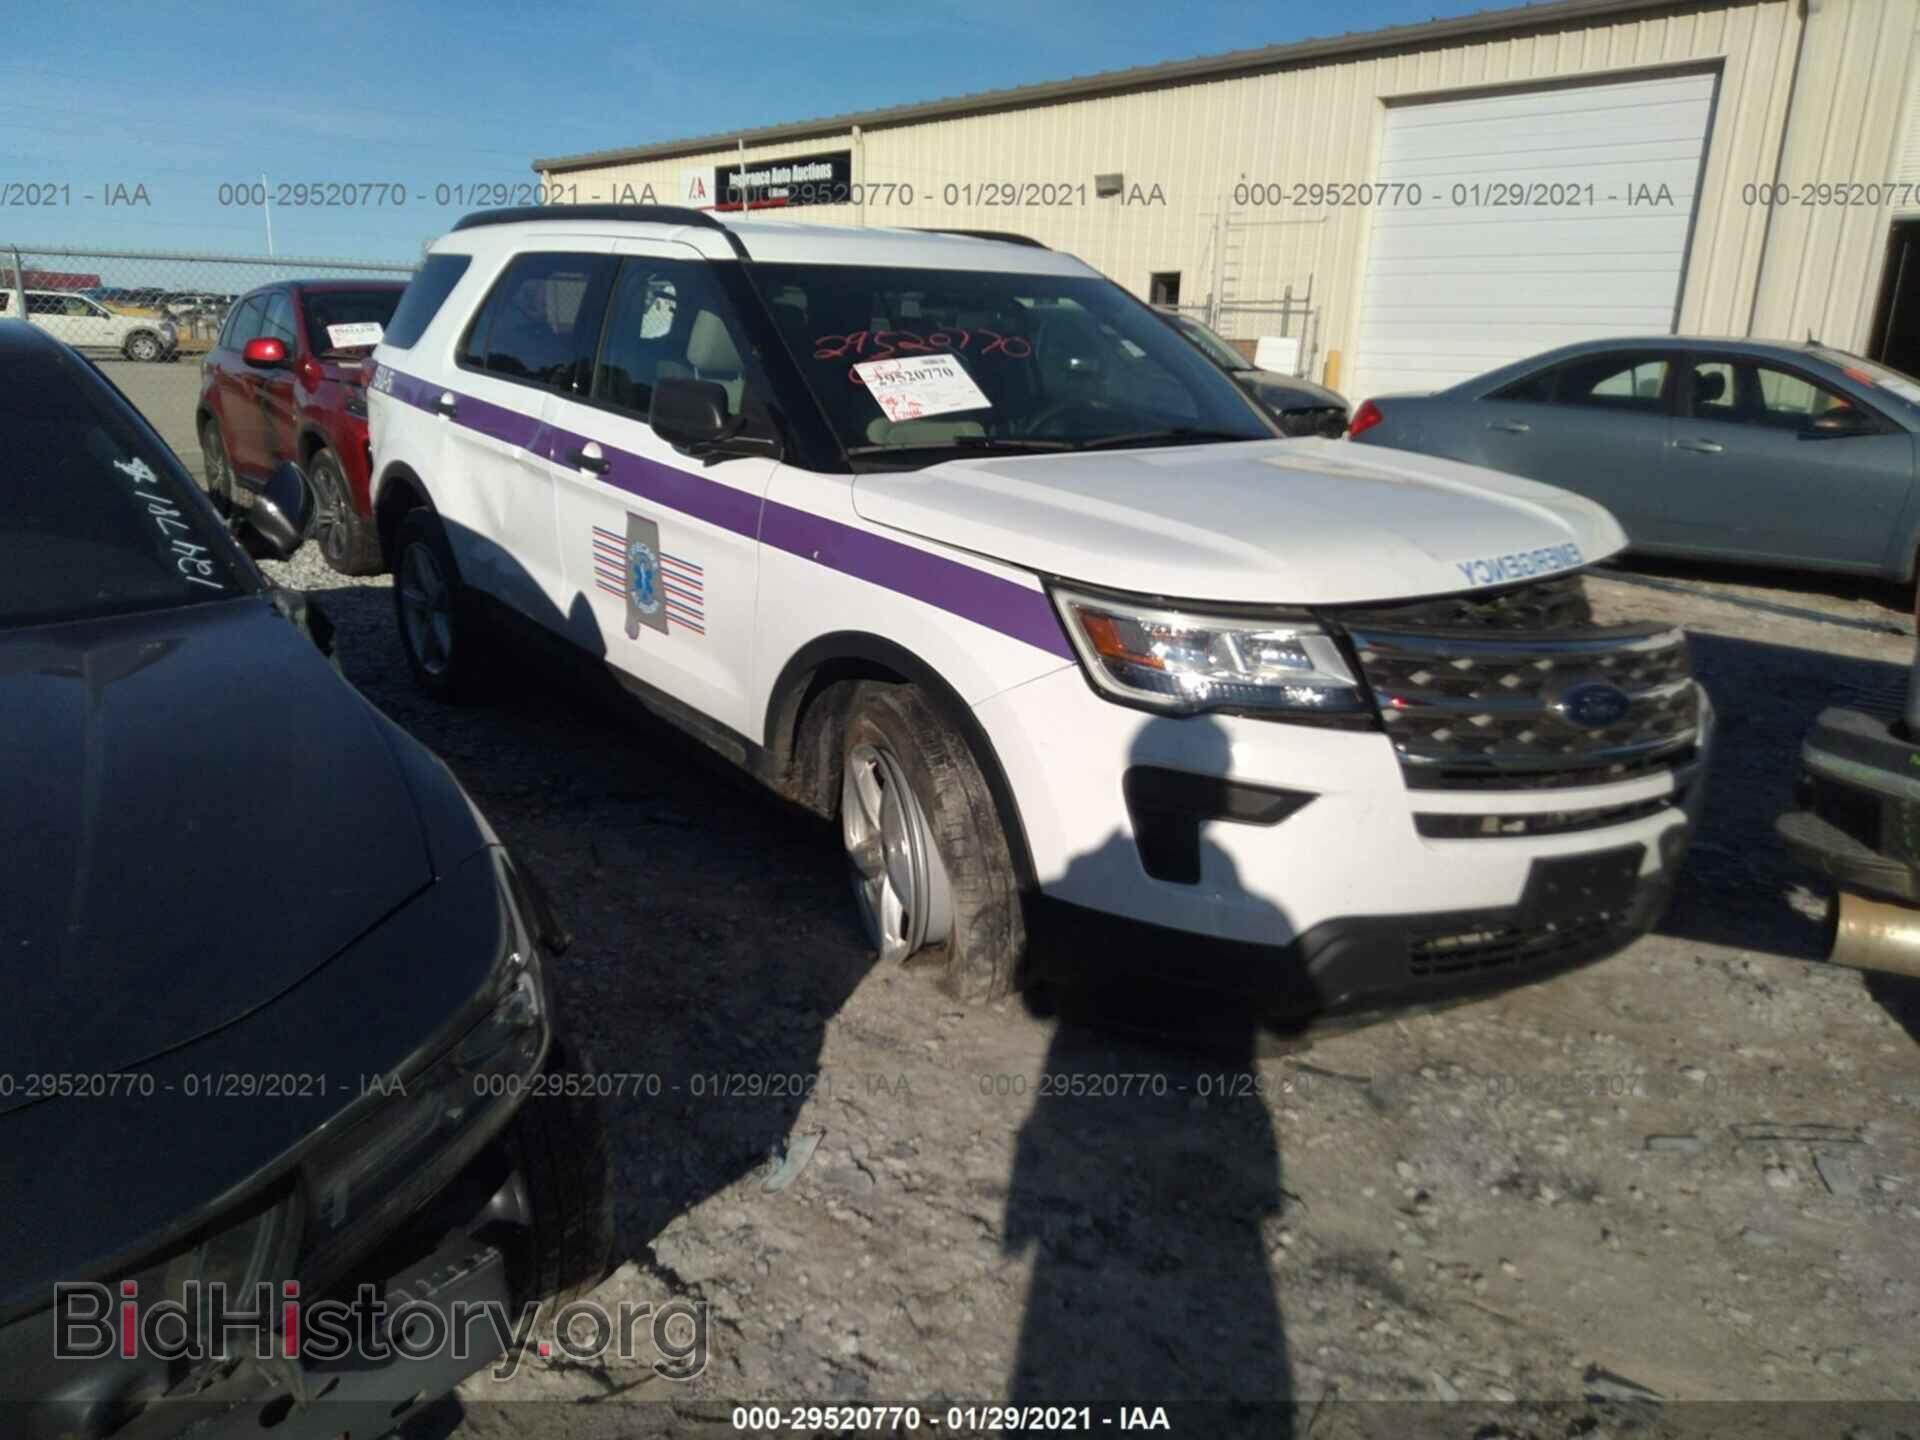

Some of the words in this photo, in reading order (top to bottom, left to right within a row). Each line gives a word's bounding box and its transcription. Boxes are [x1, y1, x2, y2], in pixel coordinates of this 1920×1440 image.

[772, 166, 791, 184] Auto
[792, 162, 833, 182] Auctions
[814, 328, 1031, 361] 29520770
[878, 367, 955, 386] 29520770
